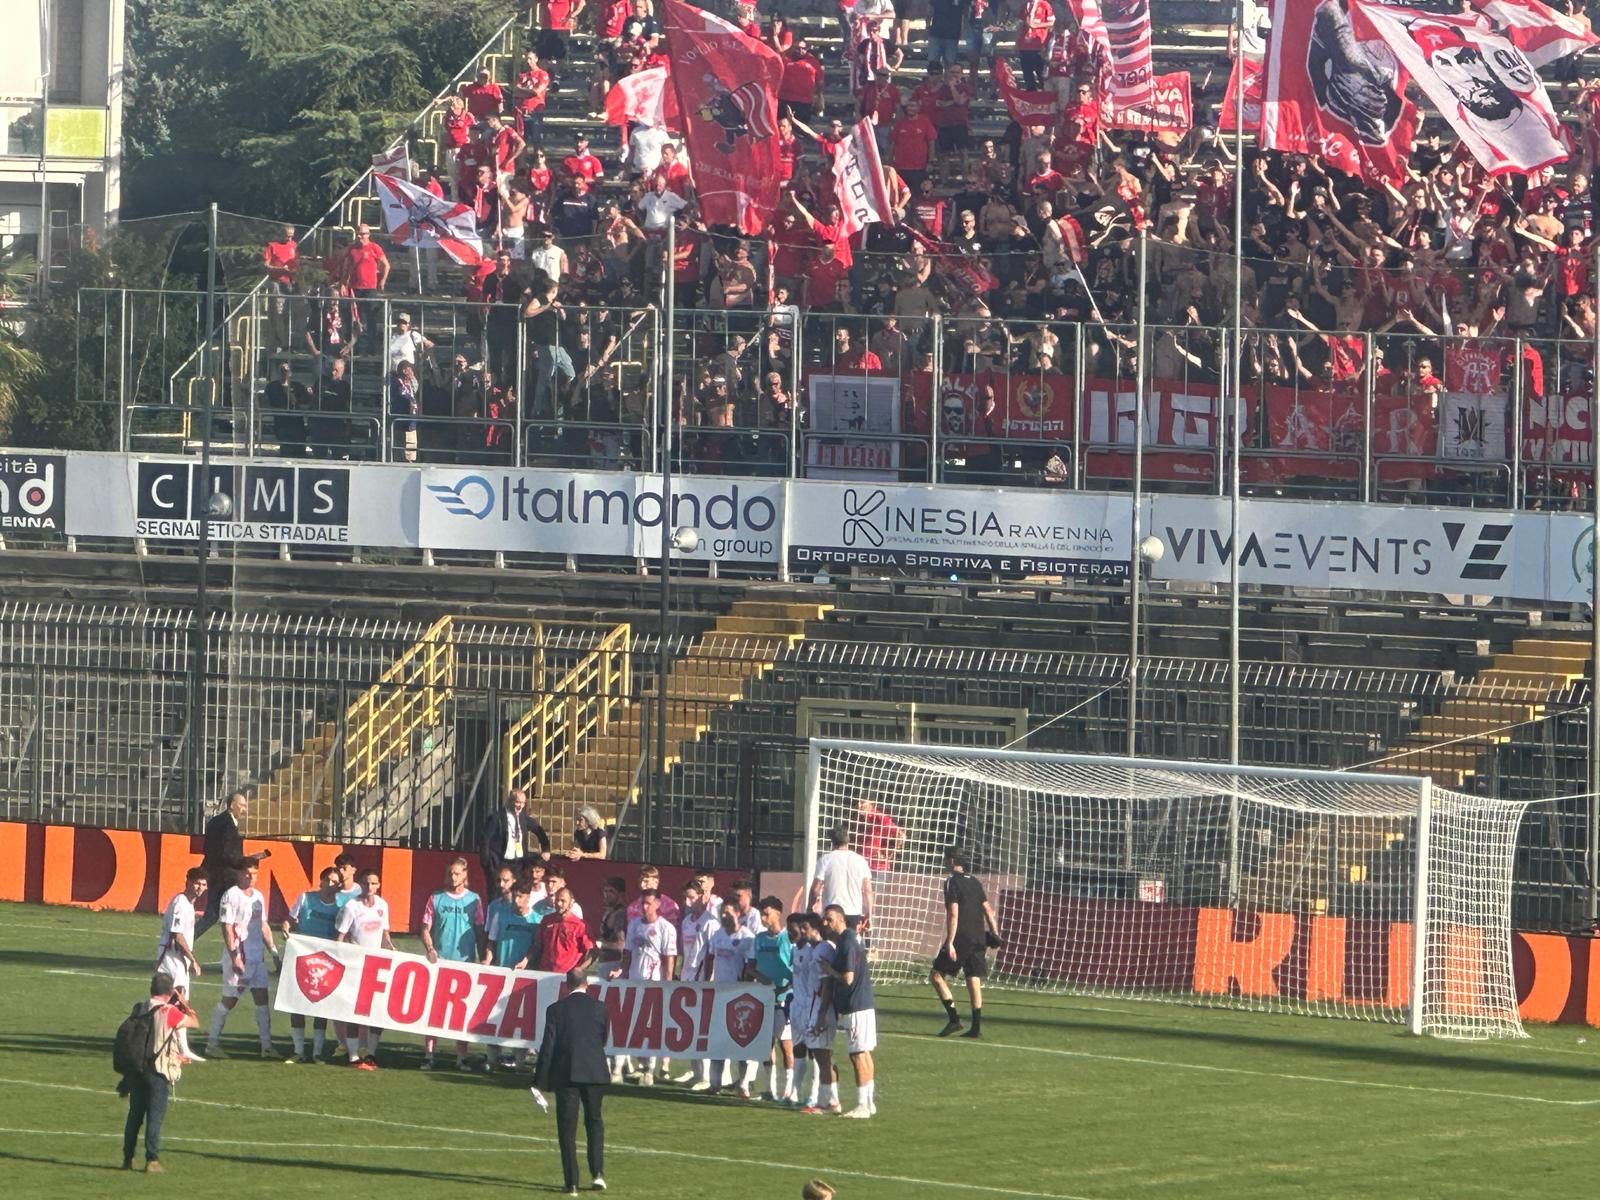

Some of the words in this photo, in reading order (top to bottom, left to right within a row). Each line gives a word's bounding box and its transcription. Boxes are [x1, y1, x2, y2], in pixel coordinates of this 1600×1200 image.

[502, 475, 776, 532] Italmondo
[0, 516, 56, 529] ENNA
[136, 520, 254, 540] SEGNALETICA
[259, 525, 349, 543] STRADALE
[1010, 524, 1113, 543] RAVENNA
[713, 538, 773, 558] group
[796, 548, 897, 565] ORTOPEDIA
[905, 553, 993, 570] SPORTIVA
[1000, 559, 1011, 571] E
[1020, 558, 1130, 576] FISIOTERAPI
[353, 954, 539, 1042] FORZA
[559, 981, 716, 1053] NAS!
